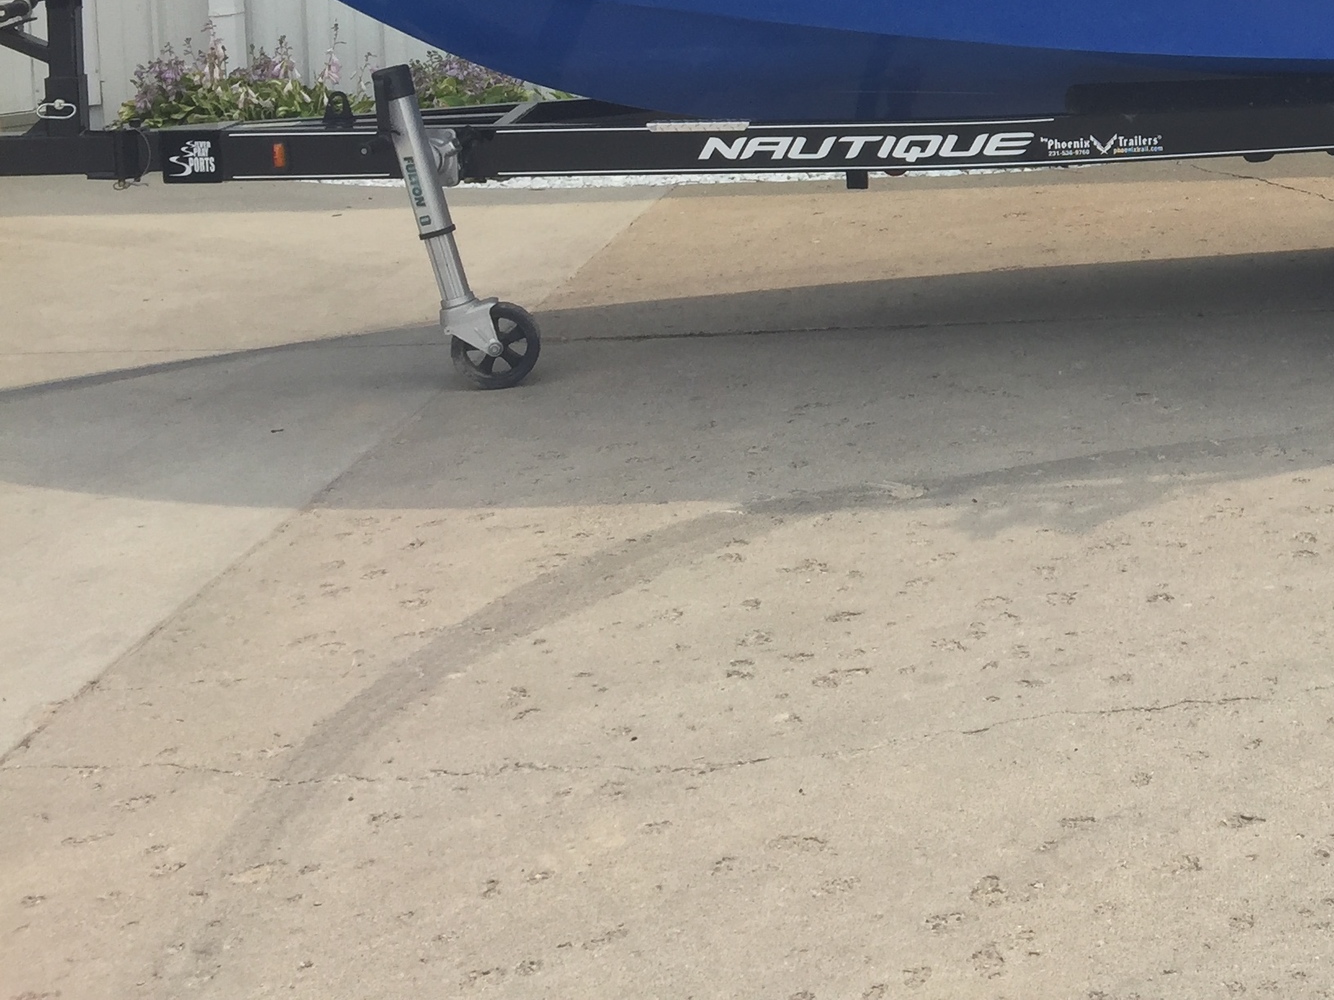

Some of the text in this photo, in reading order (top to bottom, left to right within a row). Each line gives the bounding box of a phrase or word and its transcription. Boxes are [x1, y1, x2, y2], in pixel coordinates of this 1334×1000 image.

[698, 131, 1035, 162] NAUTIQUE
[1047, 137, 1090, 150] Phoenix
[169, 155, 216, 176] SPORTS
[403, 156, 426, 207] FULTON
